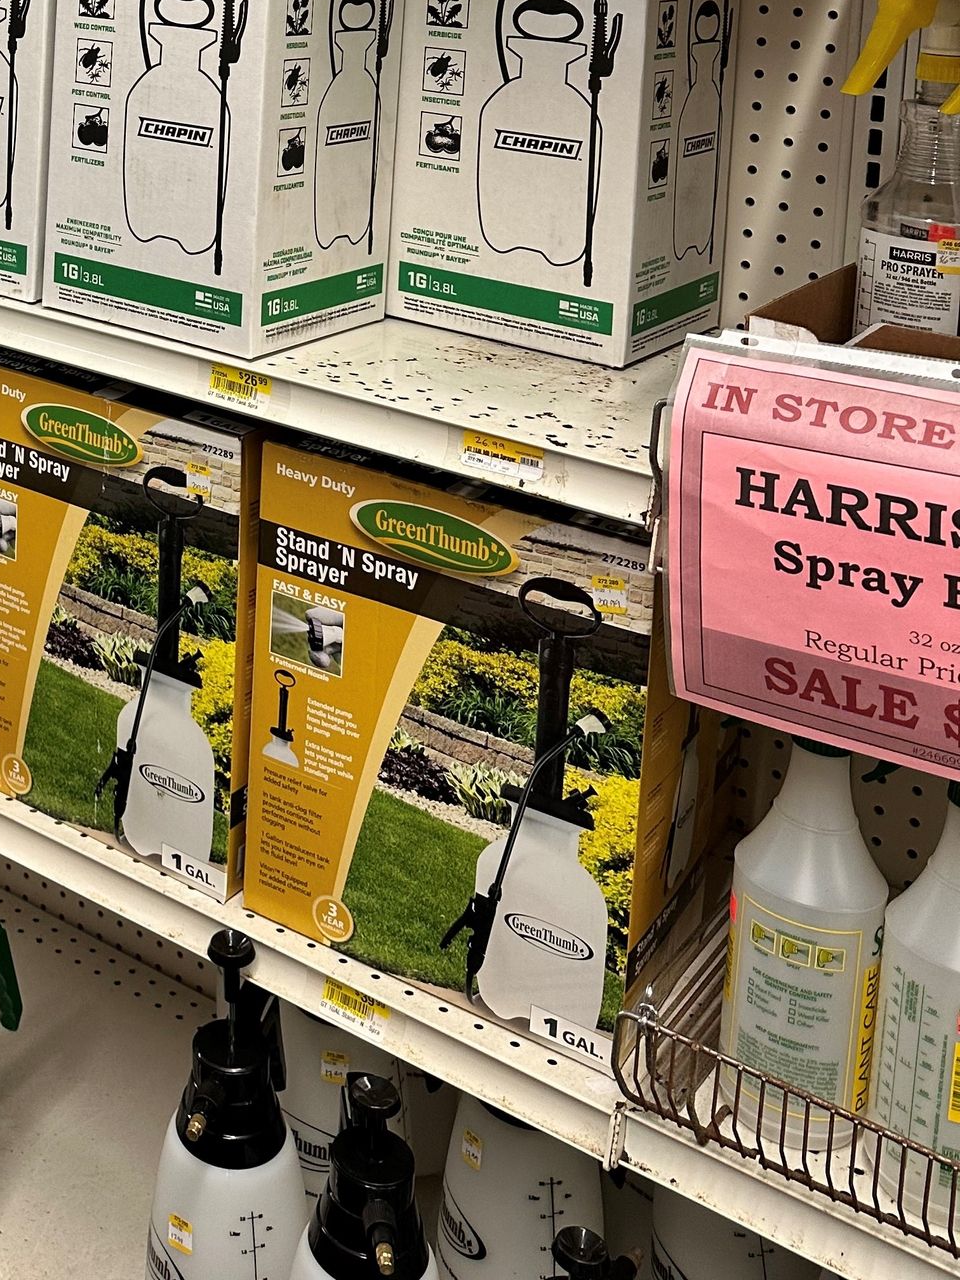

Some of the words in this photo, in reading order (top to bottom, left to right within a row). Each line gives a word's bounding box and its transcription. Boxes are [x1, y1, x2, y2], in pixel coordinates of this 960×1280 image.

[74, 23, 89, 31] WEED
[90, 23, 116, 33] CONTROL
[428, 30, 462, 40] HERBICIDE
[71, 88, 85, 97] PEST
[87, 90, 111, 100] CONTROL
[421, 95, 461, 107] INSECTICIDE
[143, 122, 207, 142] CHAPIN
[329, 124, 368, 142] CHAPIN
[501, 134, 576, 155] CHAPIN
[71, 155, 104, 167] FERTILIZERS
[415, 160, 460, 174] FERTILISANTS
[892, 249, 932, 262] HARRIS
[61, 261, 79, 280] 1G
[83, 270, 104, 287] 3.8L
[881, 260, 899, 273] PRO
[900, 265, 944, 279] SPRAYER
[407, 271, 428, 290] 1G
[432, 279, 457, 296] 3.8L
[213, 300, 230, 313] USA
[579, 310, 599, 323] USA
[1, 383, 26, 402] Duty
[701, 381, 758, 415] IN
[772, 393, 956, 451] STORE
[39, 412, 123, 454] GreenThumb
[475, 436, 505, 449] 26.99
[202, 443, 234, 460] 272289
[28, 450, 70, 482] Spray
[276, 462, 319, 488] Heavy
[321, 474, 355, 498] Duty
[375, 508, 489, 562] GreenThumb
[275, 549, 349, 586] Sprayer
[276, 527, 330, 562] Stand
[361, 551, 419, 591] Spray
[601, 552, 646, 572] 272289
[773, 539, 923, 608] Spray
[272, 579, 301, 600] FAST
[303, 587, 313, 601] &
[314, 593, 346, 612] EASY
[908, 630, 931, 646] 32
[804, 629, 908, 672] Regular
[764, 656, 920, 730] SALE
[171, 852, 183, 871] 1
[184, 862, 216, 888] GAL.
[327, 902, 338, 917] 3
[322, 914, 344, 930] YEAR
[511, 916, 580, 954] GreenThumb
[863, 968, 879, 1030] CARE
[543, 1018, 559, 1039] 1
[562, 1031, 604, 1060] GAL.
[855, 1037, 873, 1111] PLANT
